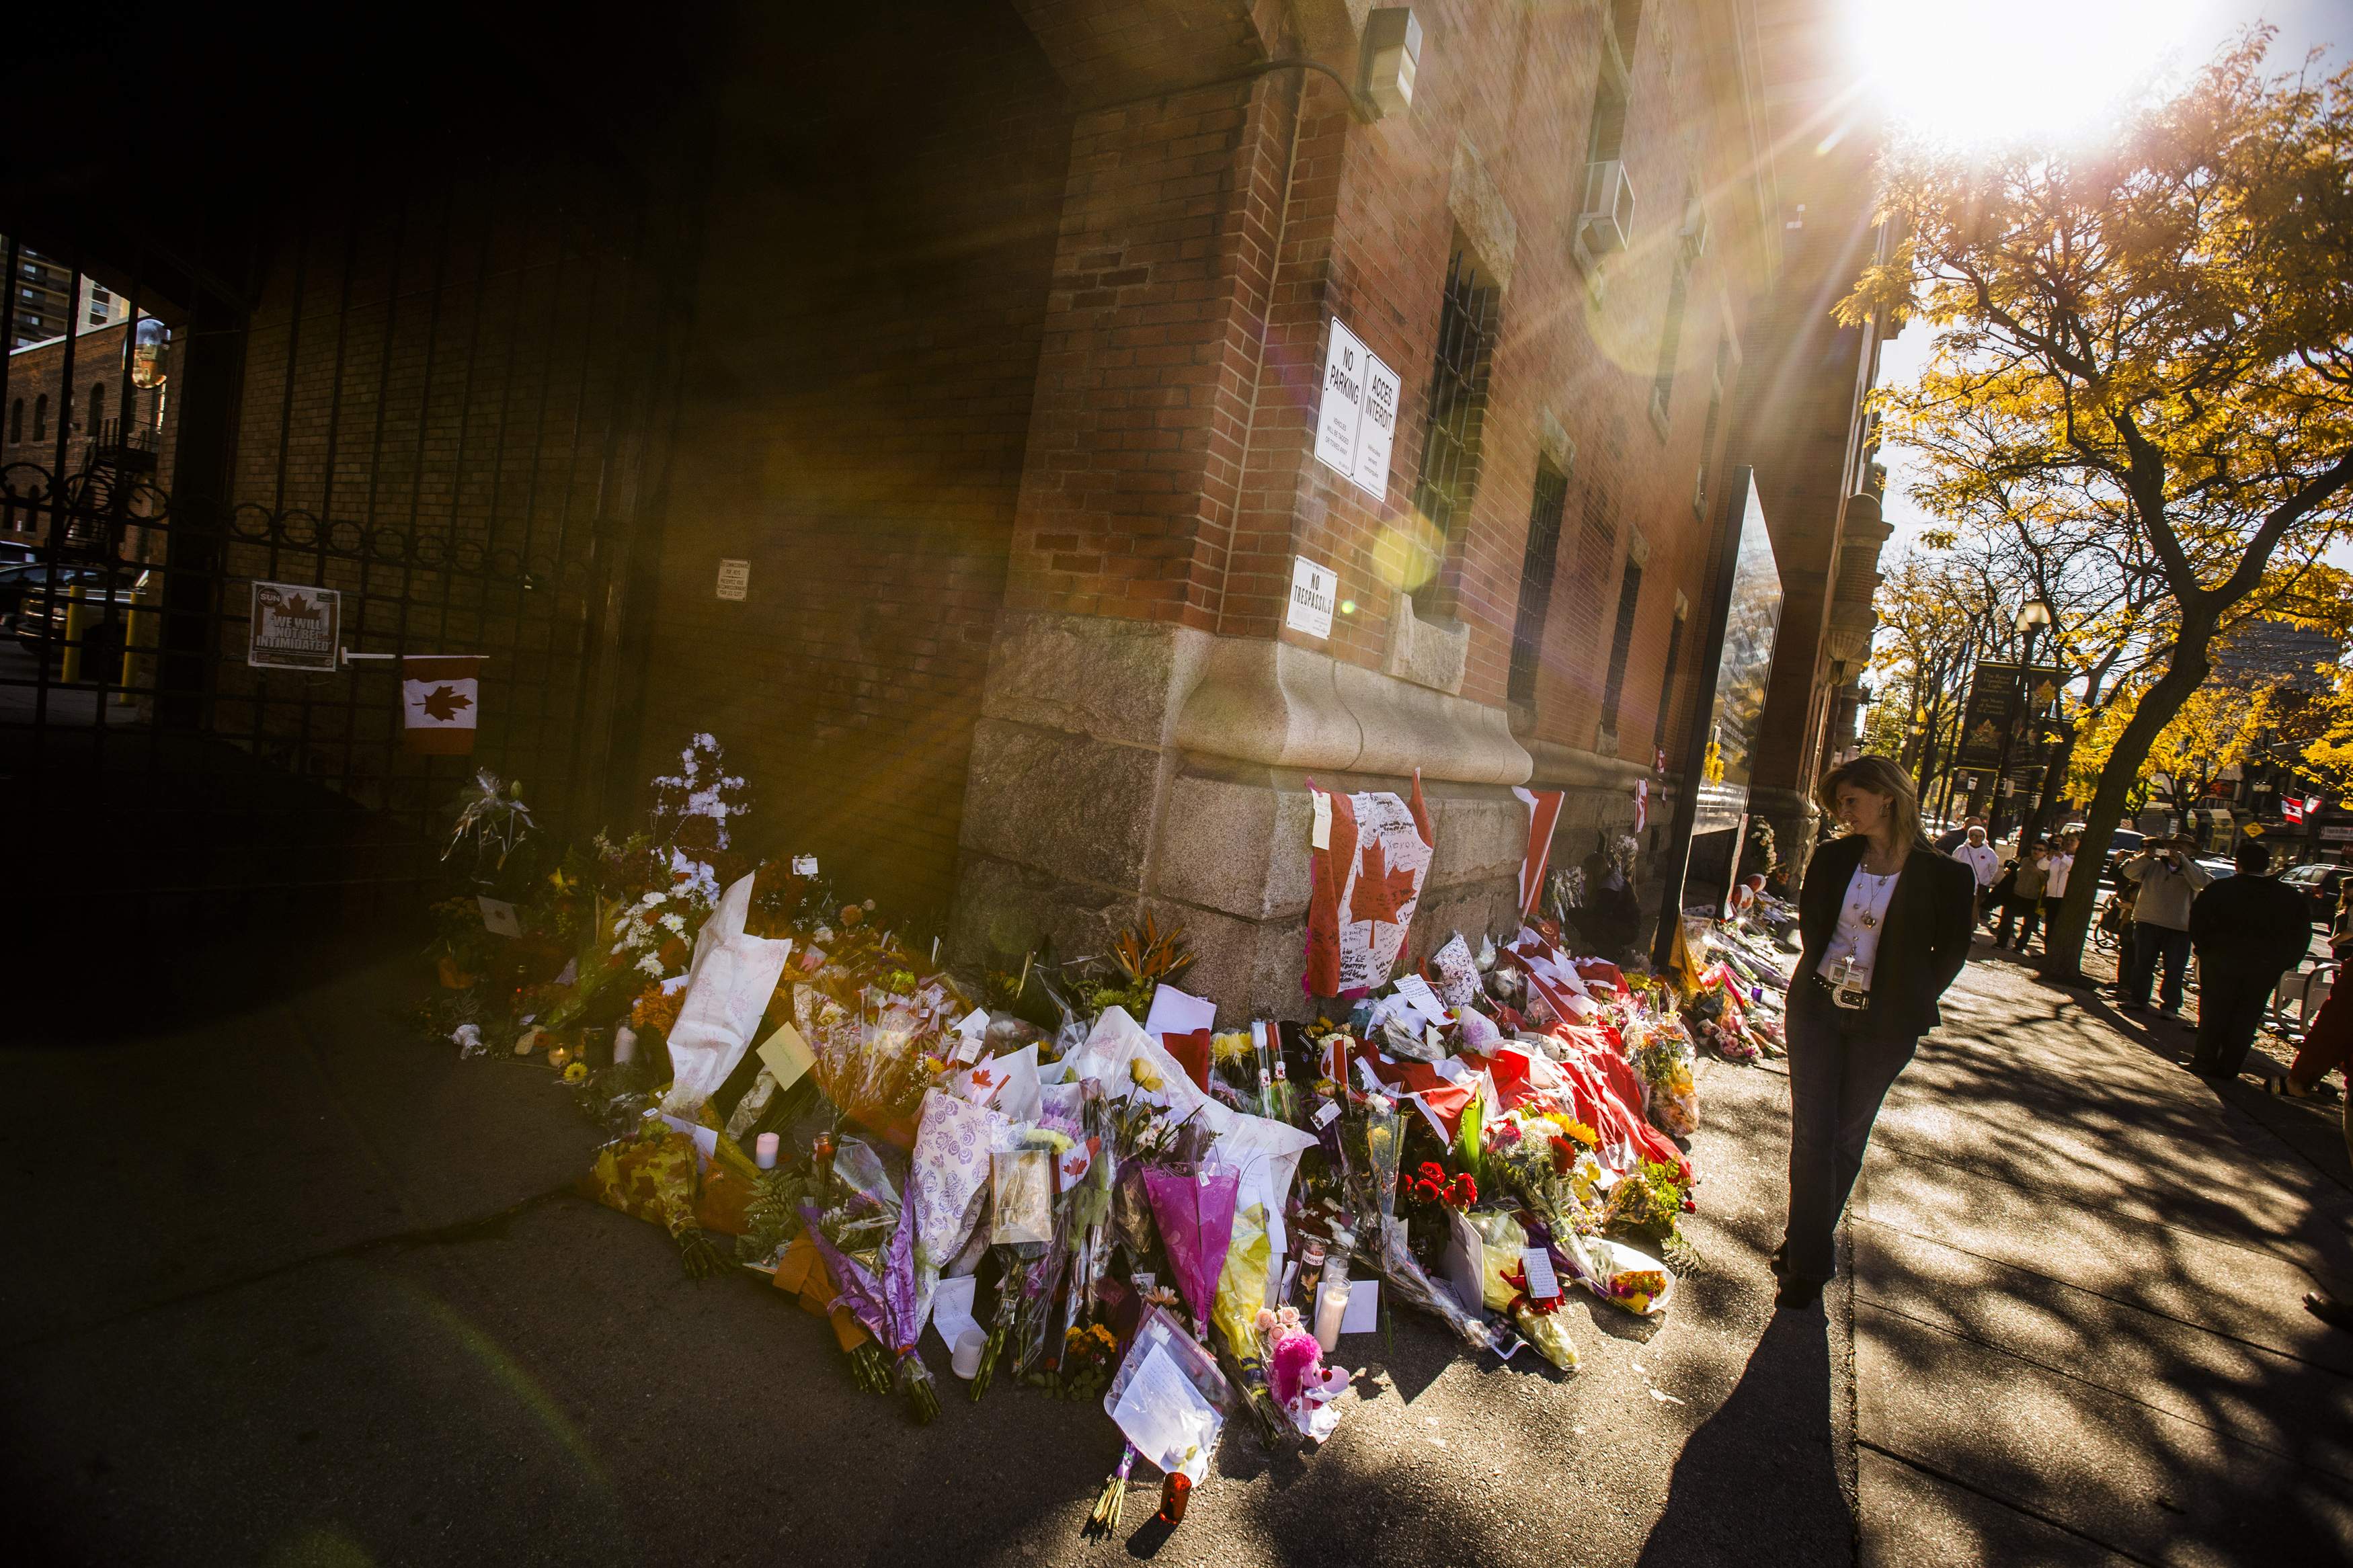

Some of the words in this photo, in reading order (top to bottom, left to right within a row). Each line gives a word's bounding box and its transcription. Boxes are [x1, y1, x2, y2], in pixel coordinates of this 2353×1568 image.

[1343, 346, 1353, 371] NO
[1330, 365, 1359, 405] PARKING
[1365, 395, 1392, 431] INTERDIT
[1311, 573, 1320, 591] NO
[260, 593, 280, 602] SUN
[294, 618, 322, 631] WILL
[277, 627, 301, 640] NOT
[1305, 1254, 1318, 1264] Living
